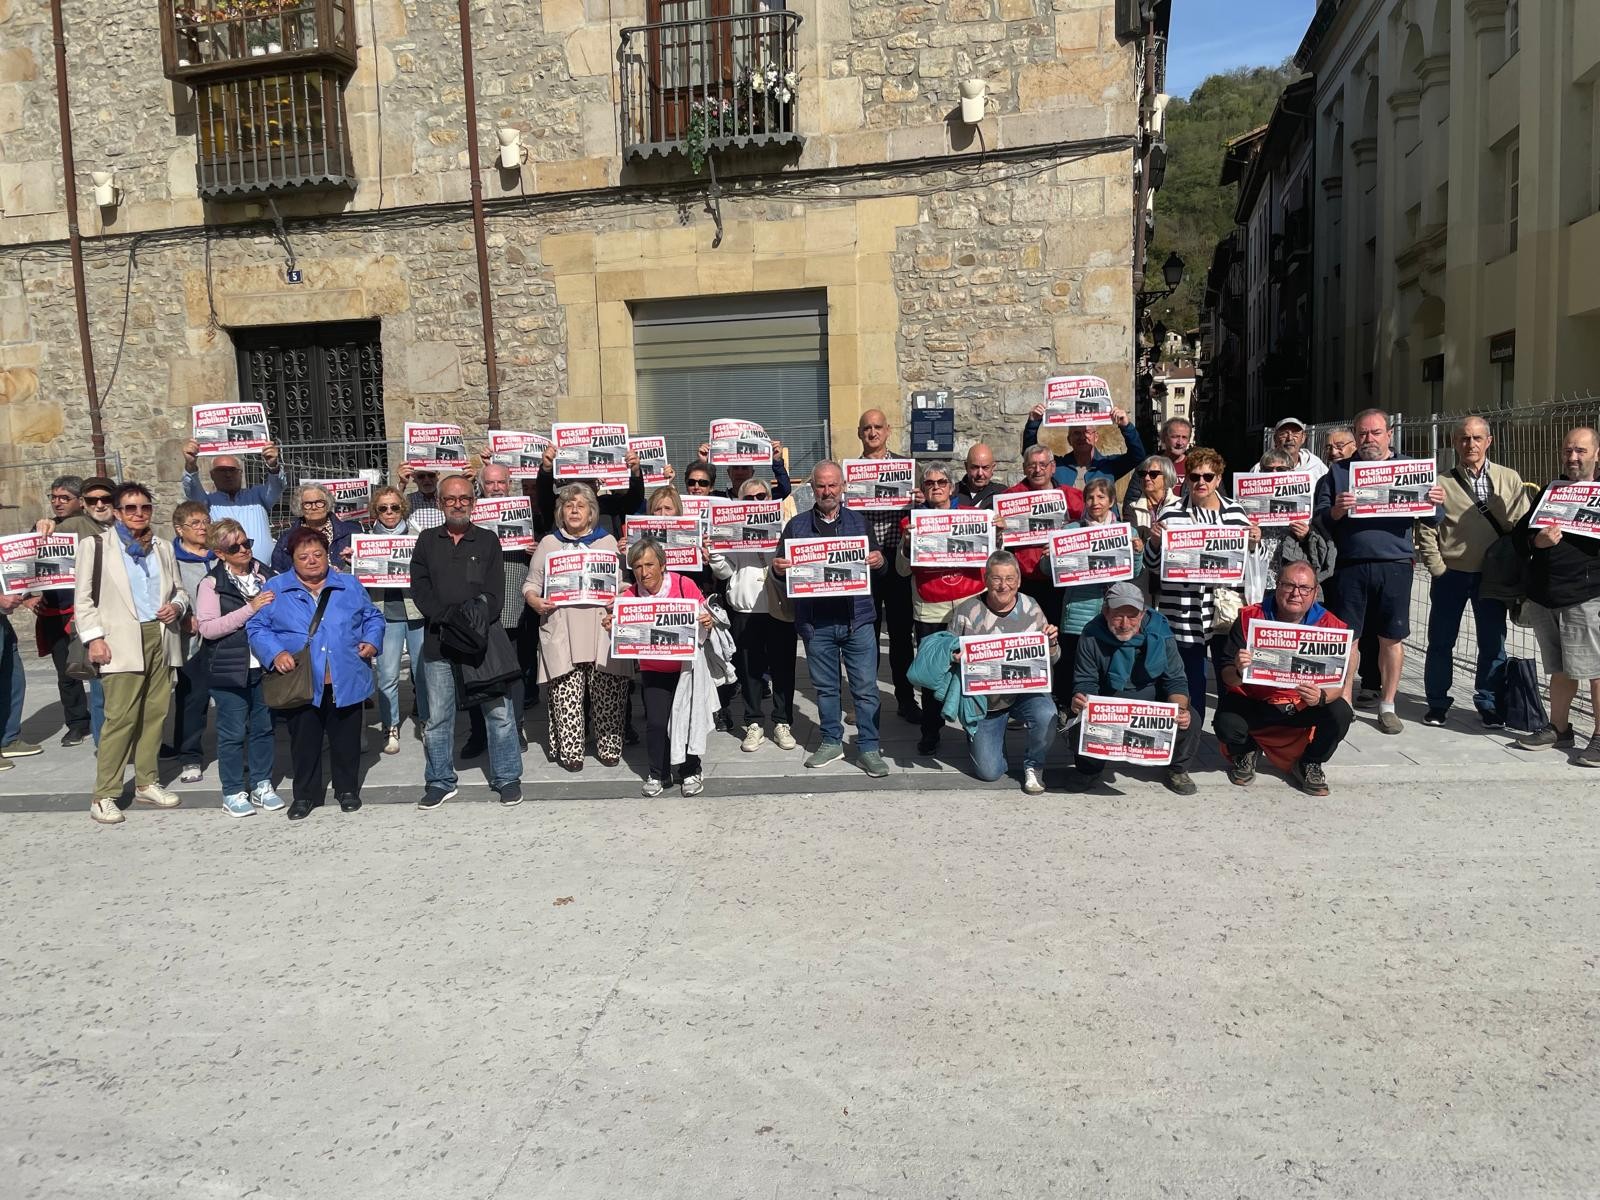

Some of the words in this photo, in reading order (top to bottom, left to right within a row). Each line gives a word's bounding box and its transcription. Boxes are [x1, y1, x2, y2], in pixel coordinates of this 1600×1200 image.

[292, 272, 298, 281] 5
[1051, 381, 1077, 390] osasun
[1050, 388, 1078, 398] publikoa
[199, 409, 227, 418] osasun
[229, 406, 259, 415] zerbitzu
[198, 415, 229, 426] publikoa
[230, 414, 263, 426] ZAINDU
[561, 430, 588, 438] osasun
[591, 427, 620, 435] zerbitzu
[560, 436, 590, 447] publikoa
[592, 434, 626, 448] ZAINDU
[632, 440, 659, 450] zerbitzu
[637, 447, 664, 460] AINDU
[851, 465, 877, 473] osasun
[879, 463, 908, 471] zerbitzu
[1360, 467, 1391, 476] osasun
[1394, 464, 1430, 473] zerbitzu
[850, 471, 878, 482] publikoa
[879, 471, 912, 482] ZAINDU
[1243, 478, 1271, 487] osasun
[1274, 475, 1306, 485] zerbitzu
[1358, 475, 1392, 486] publikoa
[1395, 472, 1434, 486] ZAINDU
[336, 481, 364, 490] zerbitzu
[1241, 485, 1272, 496] publikoa
[1275, 483, 1310, 497] ZAINDU
[337, 487, 368, 500] ZAINDU
[1551, 493, 1588, 502] publikoa
[499, 500, 528, 510] zerbitzu
[1002, 498, 1028, 508] osasun
[1031, 493, 1061, 504] zerbitzu
[716, 506, 744, 515] osasun
[746, 504, 777, 513] zerbitzu
[1001, 505, 1030, 516] publikoa
[1032, 501, 1065, 515] ZAINDU
[501, 508, 530, 522] ZAINDU
[715, 513, 745, 524] publikoa
[747, 511, 781, 525] ZAINDU
[921, 516, 949, 524] osasun
[951, 514, 985, 523] zerbitzu
[919, 523, 950, 533] publikoa
[952, 523, 988, 536] ZAINDU
[1172, 530, 1202, 539] osasun
[1205, 529, 1240, 538] zerbitzu
[1058, 534, 1087, 544] osasun
[1090, 528, 1123, 539] zerbitzu
[2, 539, 34, 551] osasun
[361, 540, 389, 548] osasun
[795, 544, 825, 554] osasun
[827, 541, 862, 551] zerbitzu
[1057, 542, 1089, 554] publikoa
[1091, 535, 1128, 552] ZAINDU
[1170, 538, 1203, 549] publikoa
[1205, 538, 1244, 551] ZAINDU
[2, 547, 37, 561] publikoa
[38, 545, 74, 559] ZAINDU
[359, 547, 390, 558] publikoa
[794, 552, 826, 564] publikoa
[828, 549, 866, 564] ZAINDU
[553, 555, 581, 565] osasun
[551, 563, 581, 574] publikoa
[623, 605, 653, 613] osasun
[656, 603, 691, 612] zerbitzu
[621, 612, 653, 623] publikoa
[656, 613, 694, 627] ZAINDU
[1260, 630, 1296, 639] osasun
[1300, 630, 1342, 641] zerbitzu
[971, 641, 1001, 651] osasun
[1004, 637, 1040, 647] zerbitzu
[1257, 637, 1297, 648] publikoa
[1299, 642, 1346, 655] ZAINDU
[970, 650, 1003, 662] publikoa
[1006, 645, 1045, 661] ZAINDU
[1094, 705, 1129, 713] osasun
[1131, 705, 1171, 716] zerbitzu
[1091, 712, 1128, 722] publikoa
[1130, 716, 1174, 729] ZAINDU
